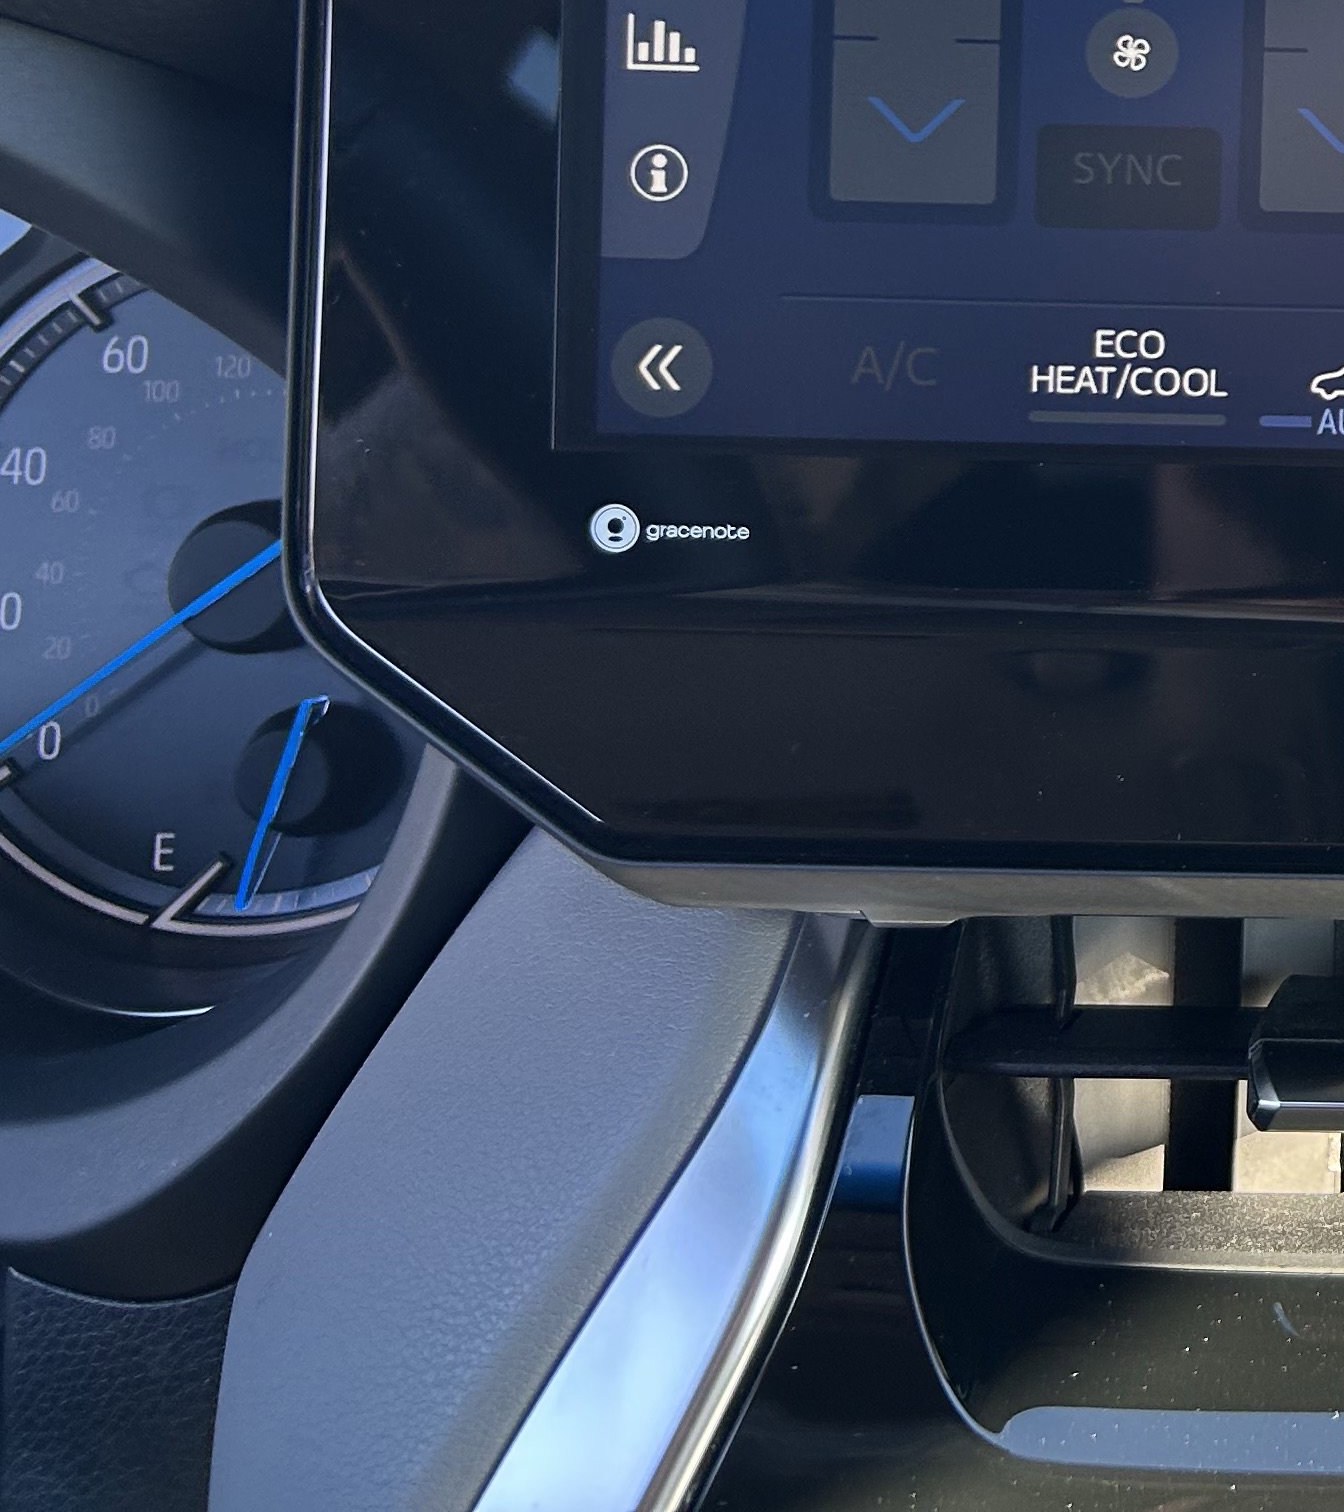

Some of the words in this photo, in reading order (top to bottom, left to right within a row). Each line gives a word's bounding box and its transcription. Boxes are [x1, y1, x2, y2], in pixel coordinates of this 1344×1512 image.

[1074, 151, 1184, 188] SYNC
[101, 334, 150, 375] 60
[1094, 328, 1167, 361] ECO
[214, 354, 252, 379] 120
[851, 340, 939, 393] A/C
[1030, 363, 1229, 400] HEAT/COOL
[142, 379, 182, 404] 100
[86, 424, 118, 451] 80
[0, 445, 48, 487] 40
[644, 523, 751, 543] gracenote
[37, 719, 63, 762] 0
[152, 831, 178, 872] E
